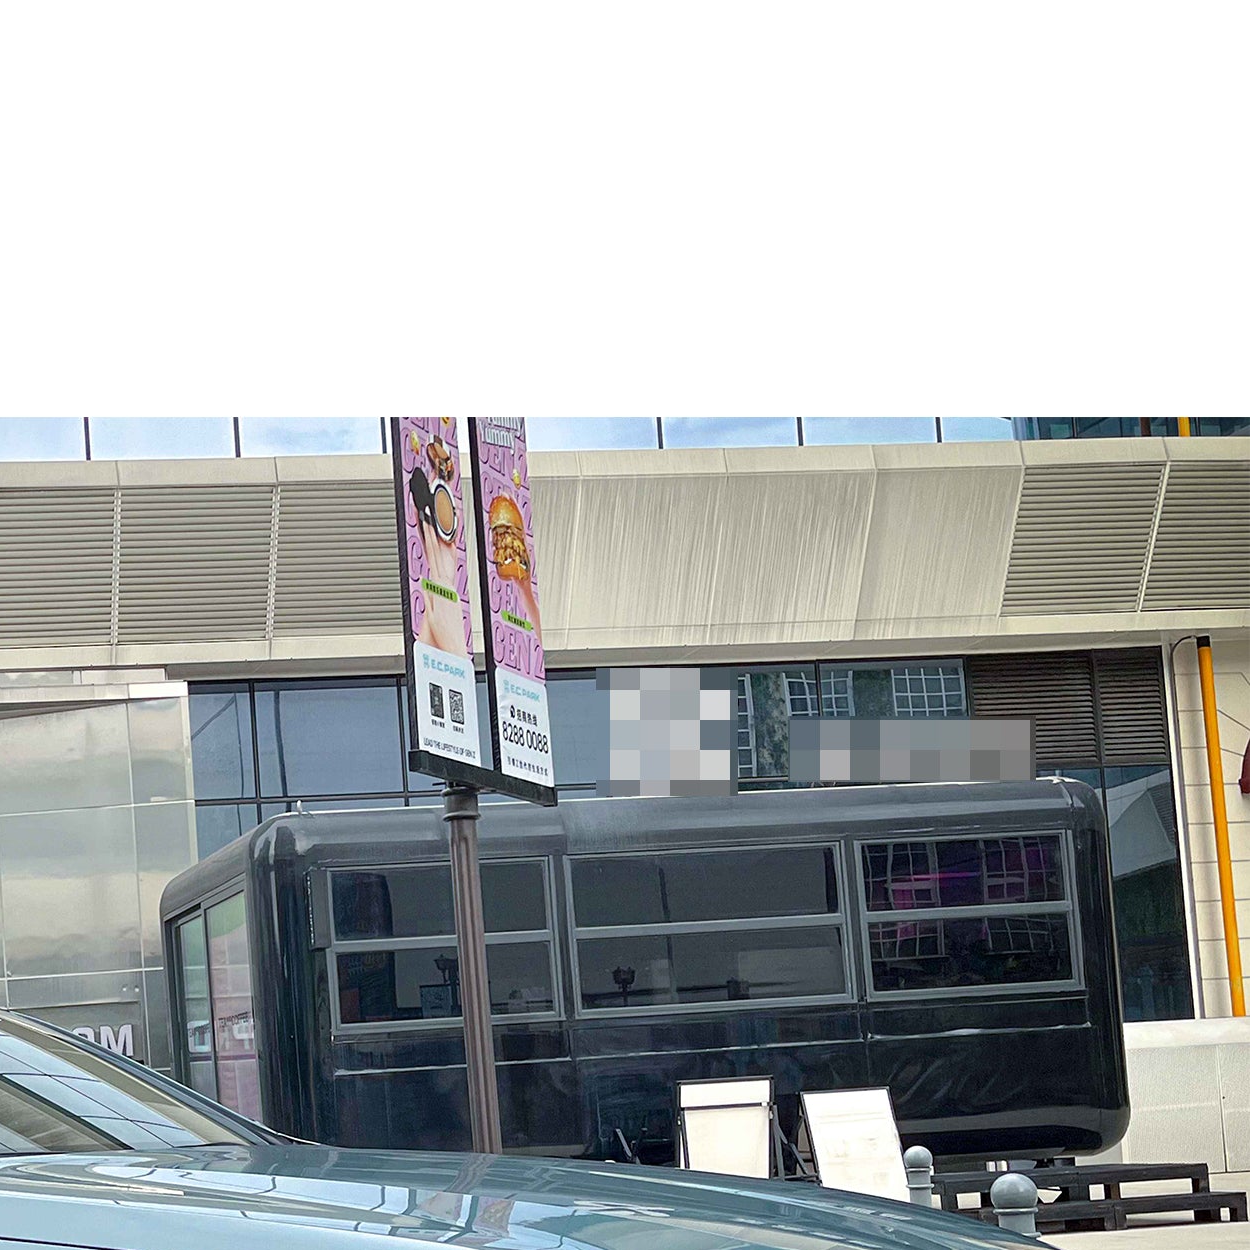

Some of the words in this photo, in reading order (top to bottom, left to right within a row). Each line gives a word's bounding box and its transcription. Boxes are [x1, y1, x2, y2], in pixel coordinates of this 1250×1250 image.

[478, 420, 515, 455] Yummy
[492, 620, 532, 675] GEN
[534, 638, 546, 680] Z
[502, 720, 525, 747] 8288
[526, 729, 549, 754] 0088
